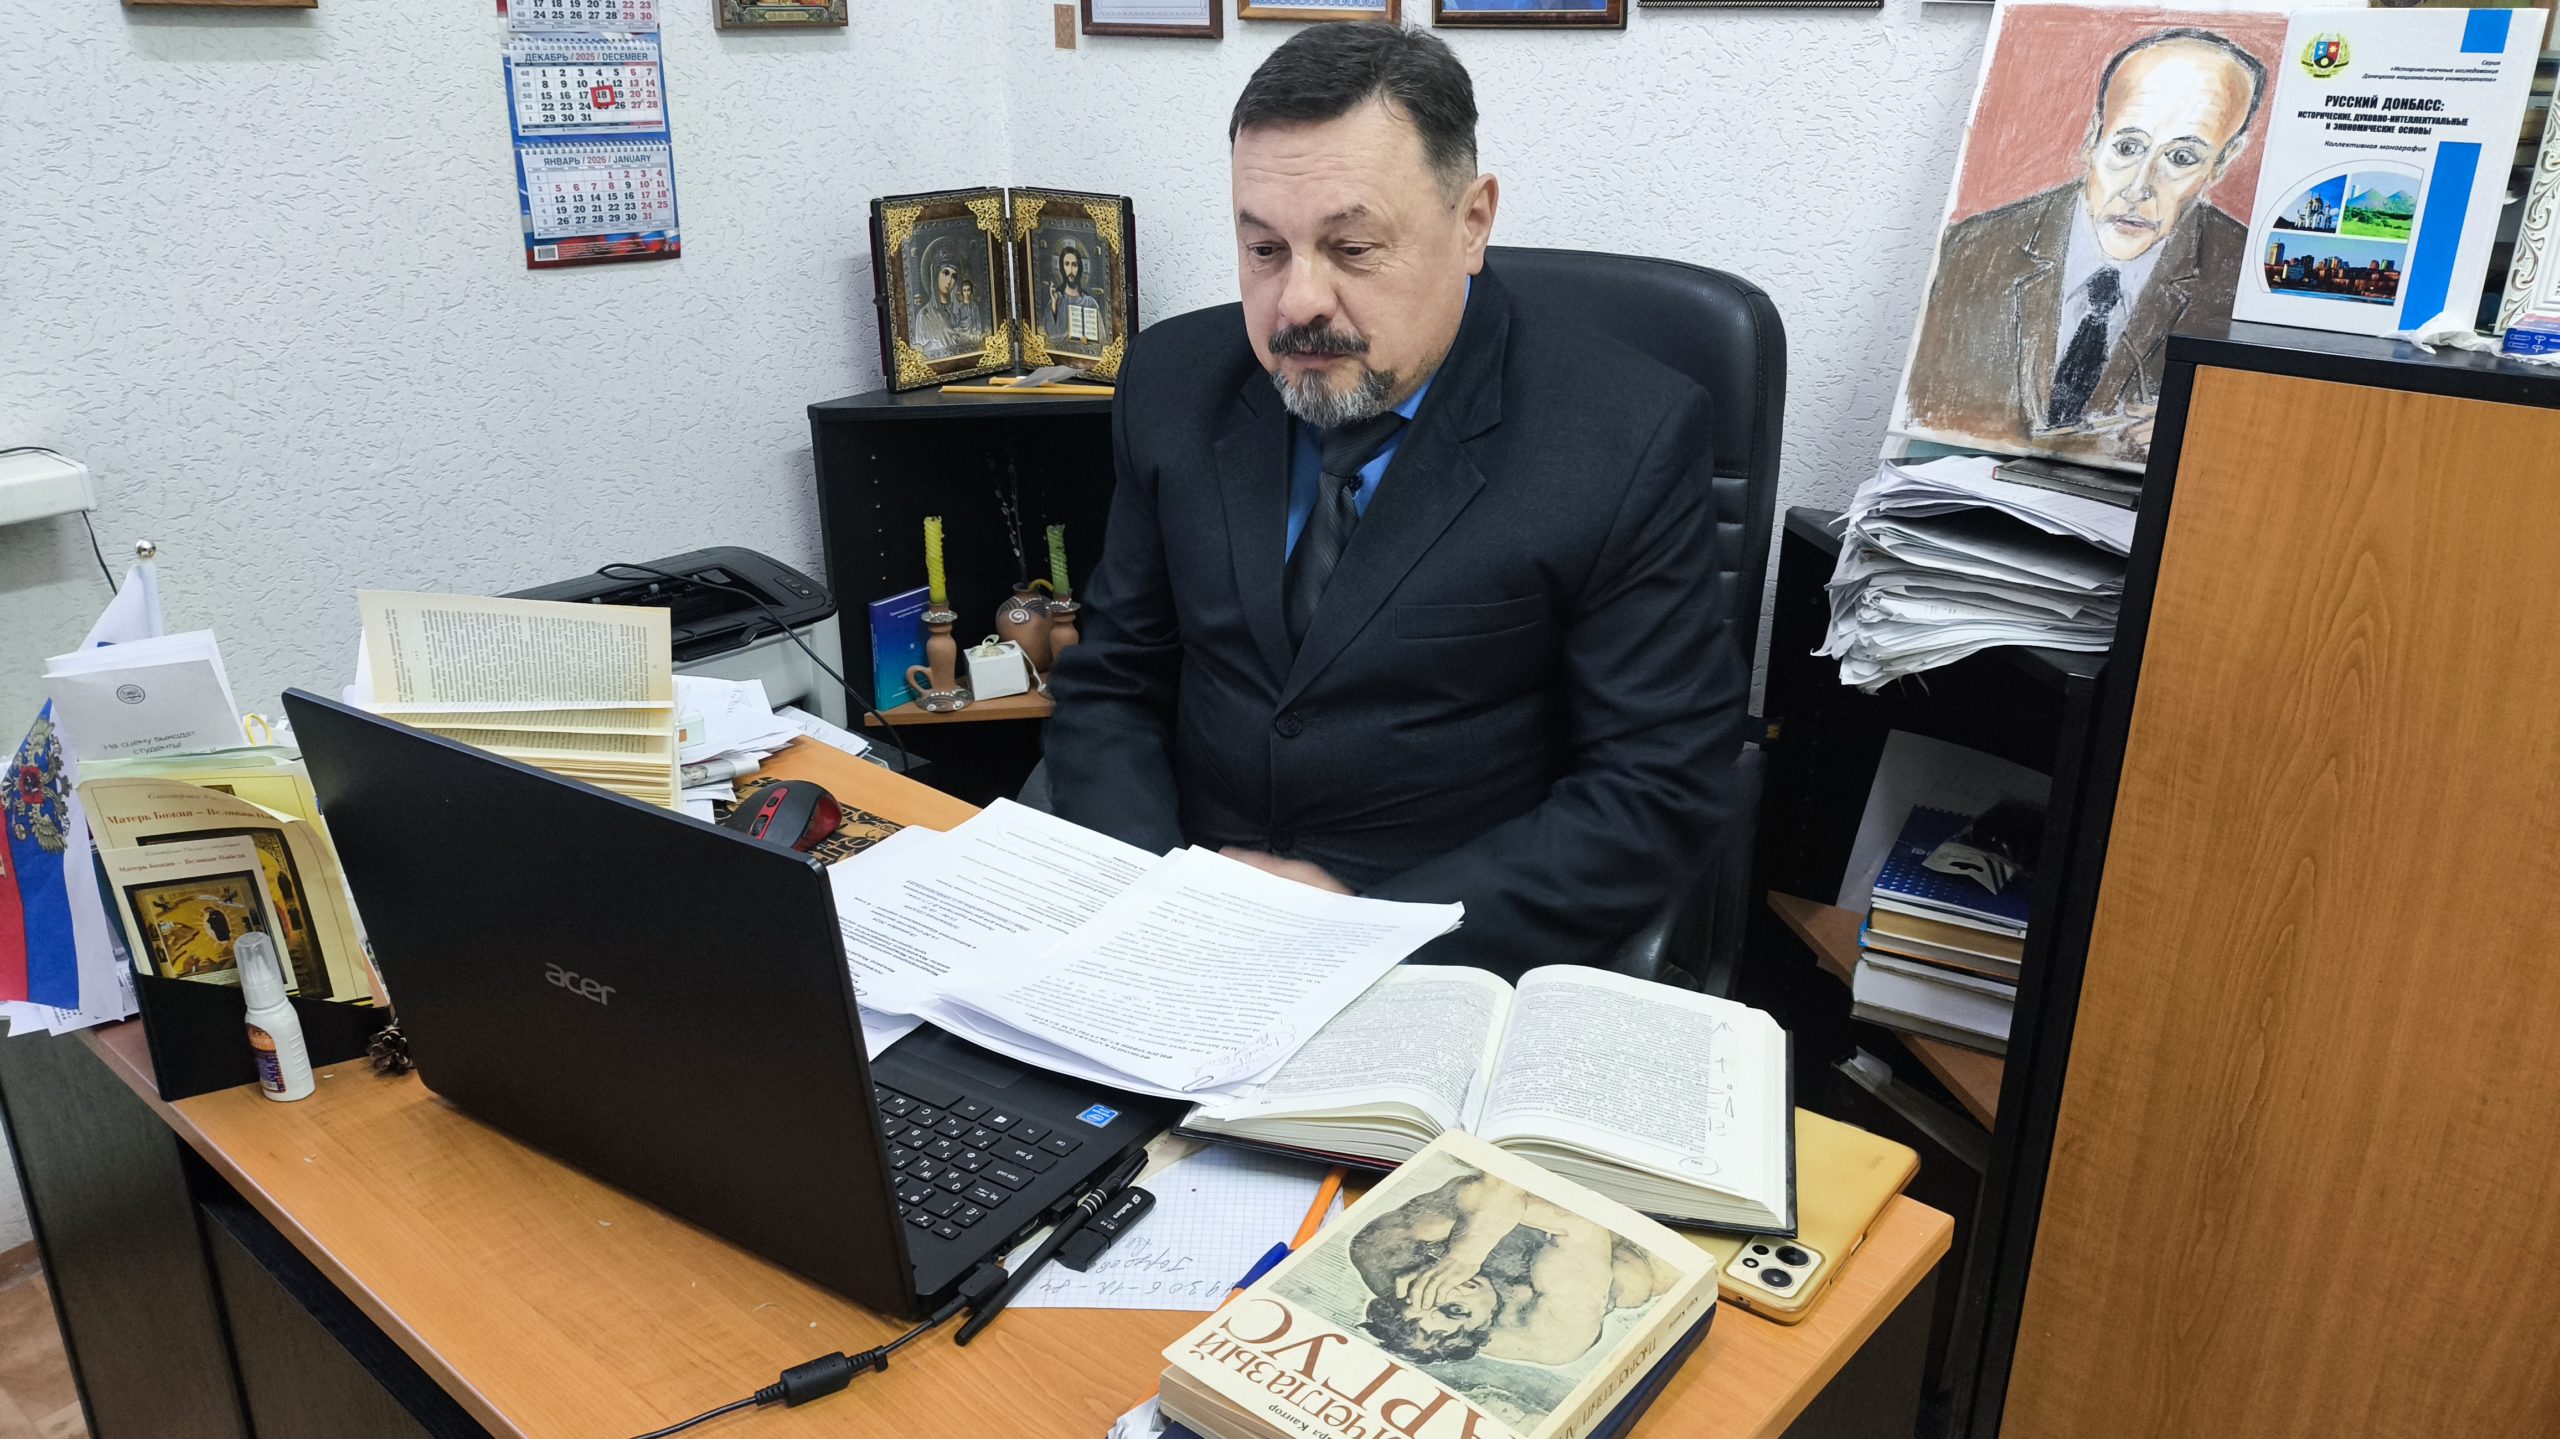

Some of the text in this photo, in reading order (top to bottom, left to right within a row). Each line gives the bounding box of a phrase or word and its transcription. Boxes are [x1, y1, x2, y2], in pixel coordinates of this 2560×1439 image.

[622, 0, 634, 9] 22
[640, 0, 651, 9] 23
[533, 11, 546, 19] 24
[552, 11, 564, 19] 25
[570, 11, 582, 19] 26
[588, 11, 600, 19] 27
[605, 11, 618, 20] 28
[623, 11, 635, 20] 29
[525, 53, 568, 63] ДЕКАБРЬ
[576, 52, 595, 60] 2025
[602, 52, 648, 61] DECEMBER
[578, 69, 584, 77] 3
[595, 69, 603, 77] 4
[2362, 73, 2395, 82] Донецкого
[542, 80, 549, 88] 8
[561, 80, 567, 88] 9
[576, 80, 588, 88] 10
[612, 80, 623, 88] 12
[630, 79, 639, 87] 13
[646, 79, 655, 87] 14
[541, 90, 657, 100] 15 16 17 18 19 20 21
[541, 103, 554, 111] 22
[560, 102, 573, 111] 23
[578, 102, 591, 110] 24
[614, 101, 626, 110] 26
[631, 101, 641, 109] 27
[646, 101, 658, 109] 28
[2324, 94, 2445, 112] РУССКИЙ ДОНБАСС:
[543, 113, 592, 122] 29 30 31
[2298, 110, 2468, 126] ИСТОРИЧЕСКИЕ, ДУХОВНО-ИНТЕЛЛЕКТУАЛЬНЫЕ
[2333, 123, 2395, 133] ЭКОНОМИЧЕСКИЕ
[2398, 126, 2432, 135] ОСНОВЫ
[2324, 140, 2378, 150] Коллективная
[544, 154, 651, 166] ЯНВАРЬ 2026 JANUARY
[557, 217, 569, 225] 26
[154, 730, 195, 742] выходят
[107, 812, 152, 825] Матерь
[154, 809, 193, 820] Божия
[118, 864, 148, 872] Матерь
[545, 962, 616, 1006] acer
[920, 1170, 932, 1178] W
[1267, 1403, 1310, 1432] Кантор
